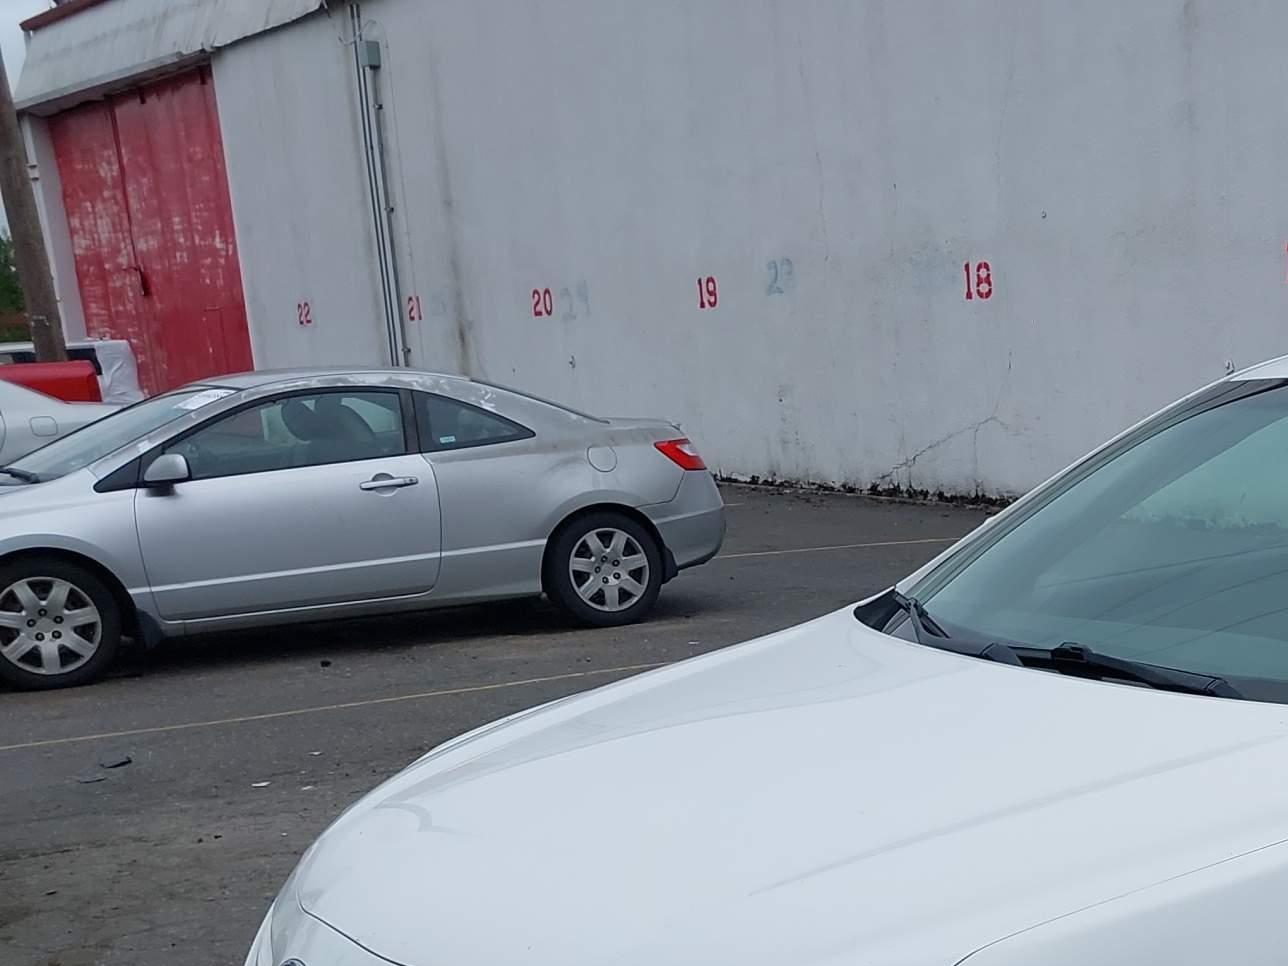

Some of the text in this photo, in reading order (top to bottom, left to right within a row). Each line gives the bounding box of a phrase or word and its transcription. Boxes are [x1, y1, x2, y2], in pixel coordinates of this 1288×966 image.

[696, 276, 718, 309] 19
[964, 261, 992, 300] 18
[298, 302, 312, 325] 22
[408, 296, 422, 321] 21
[532, 288, 553, 317] 20
